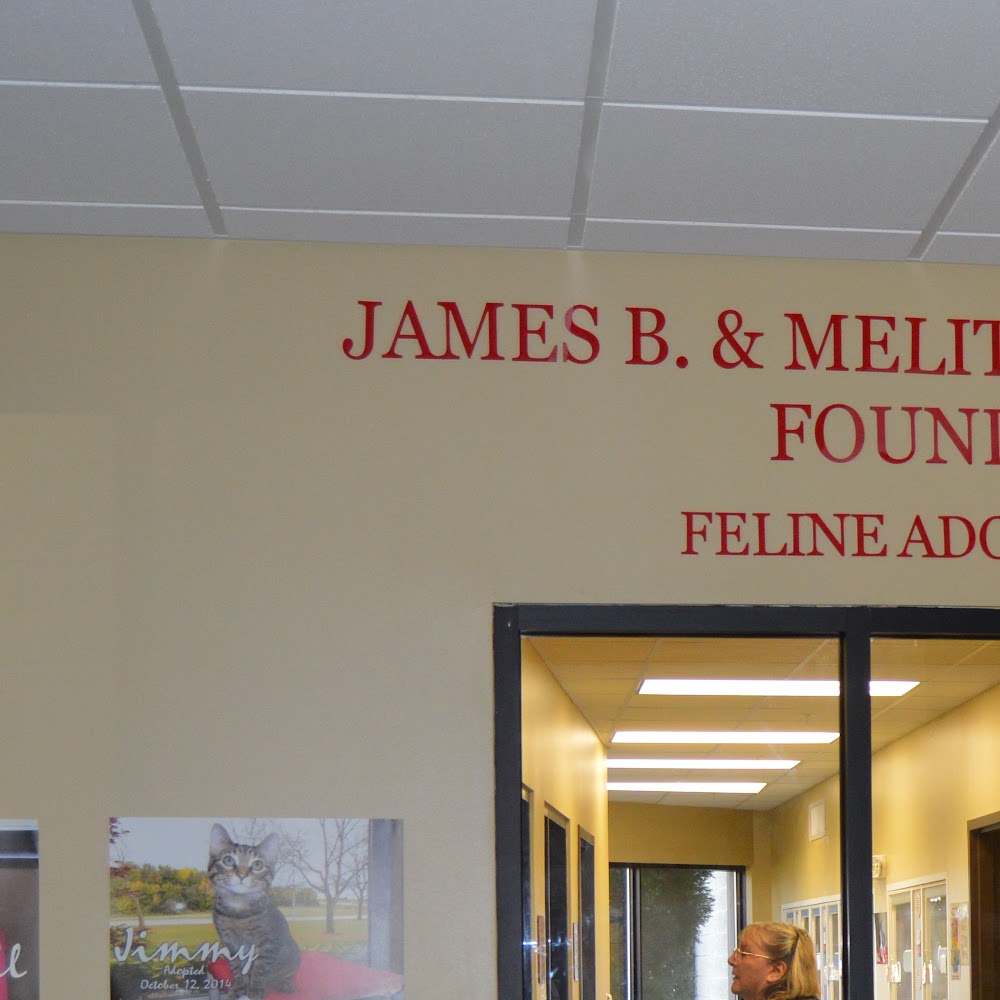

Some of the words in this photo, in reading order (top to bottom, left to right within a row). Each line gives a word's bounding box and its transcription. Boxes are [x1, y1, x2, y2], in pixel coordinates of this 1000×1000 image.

[342, 300, 600, 364] JAMES
[625, 306, 689, 369] B.
[712, 308, 764, 369] &
[681, 511, 888, 557] FELINE
[114, 927, 259, 976] Jimmy
[163, 965, 206, 978] Adopted
[140, 979, 180, 990] October
[184, 979, 200, 991] 12,
[203, 979, 232, 989] 2014
